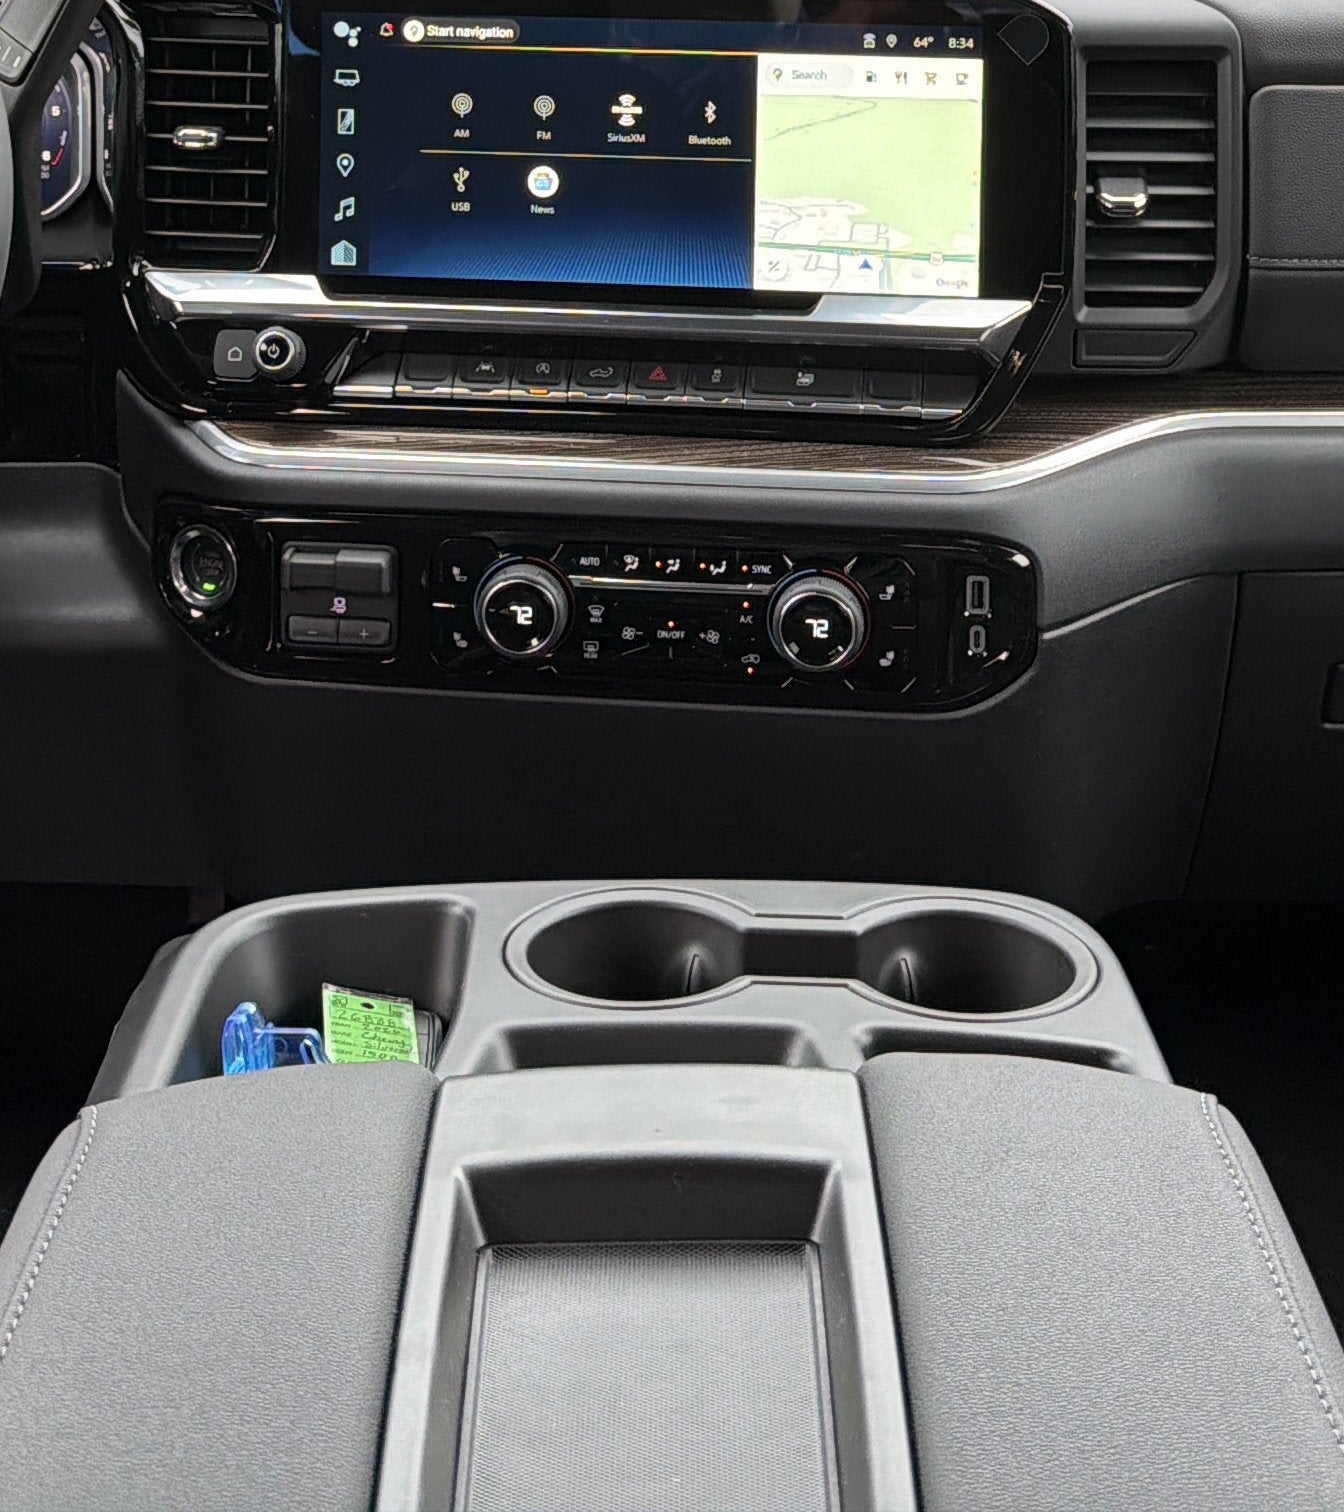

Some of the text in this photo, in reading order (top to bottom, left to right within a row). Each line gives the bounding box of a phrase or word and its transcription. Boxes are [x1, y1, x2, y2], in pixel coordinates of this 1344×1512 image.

[426, 25, 514, 40] Start navigation
[948, 37, 974, 49] 8:34
[792, 69, 827, 81] Search
[453, 129, 470, 137] AM
[536, 131, 552, 140] FM
[607, 133, 646, 142] SiriusXM
[688, 135, 732, 145] Bluetooth
[451, 202, 471, 212] USB
[530, 205, 555, 215] News
[579, 557, 600, 567] AUTO
[751, 564, 772, 575] SYNC
[509, 605, 533, 625] 72
[739, 615, 754, 624] A/C
[805, 618, 829, 639] 72
[656, 630, 686, 639] ON/OFF
